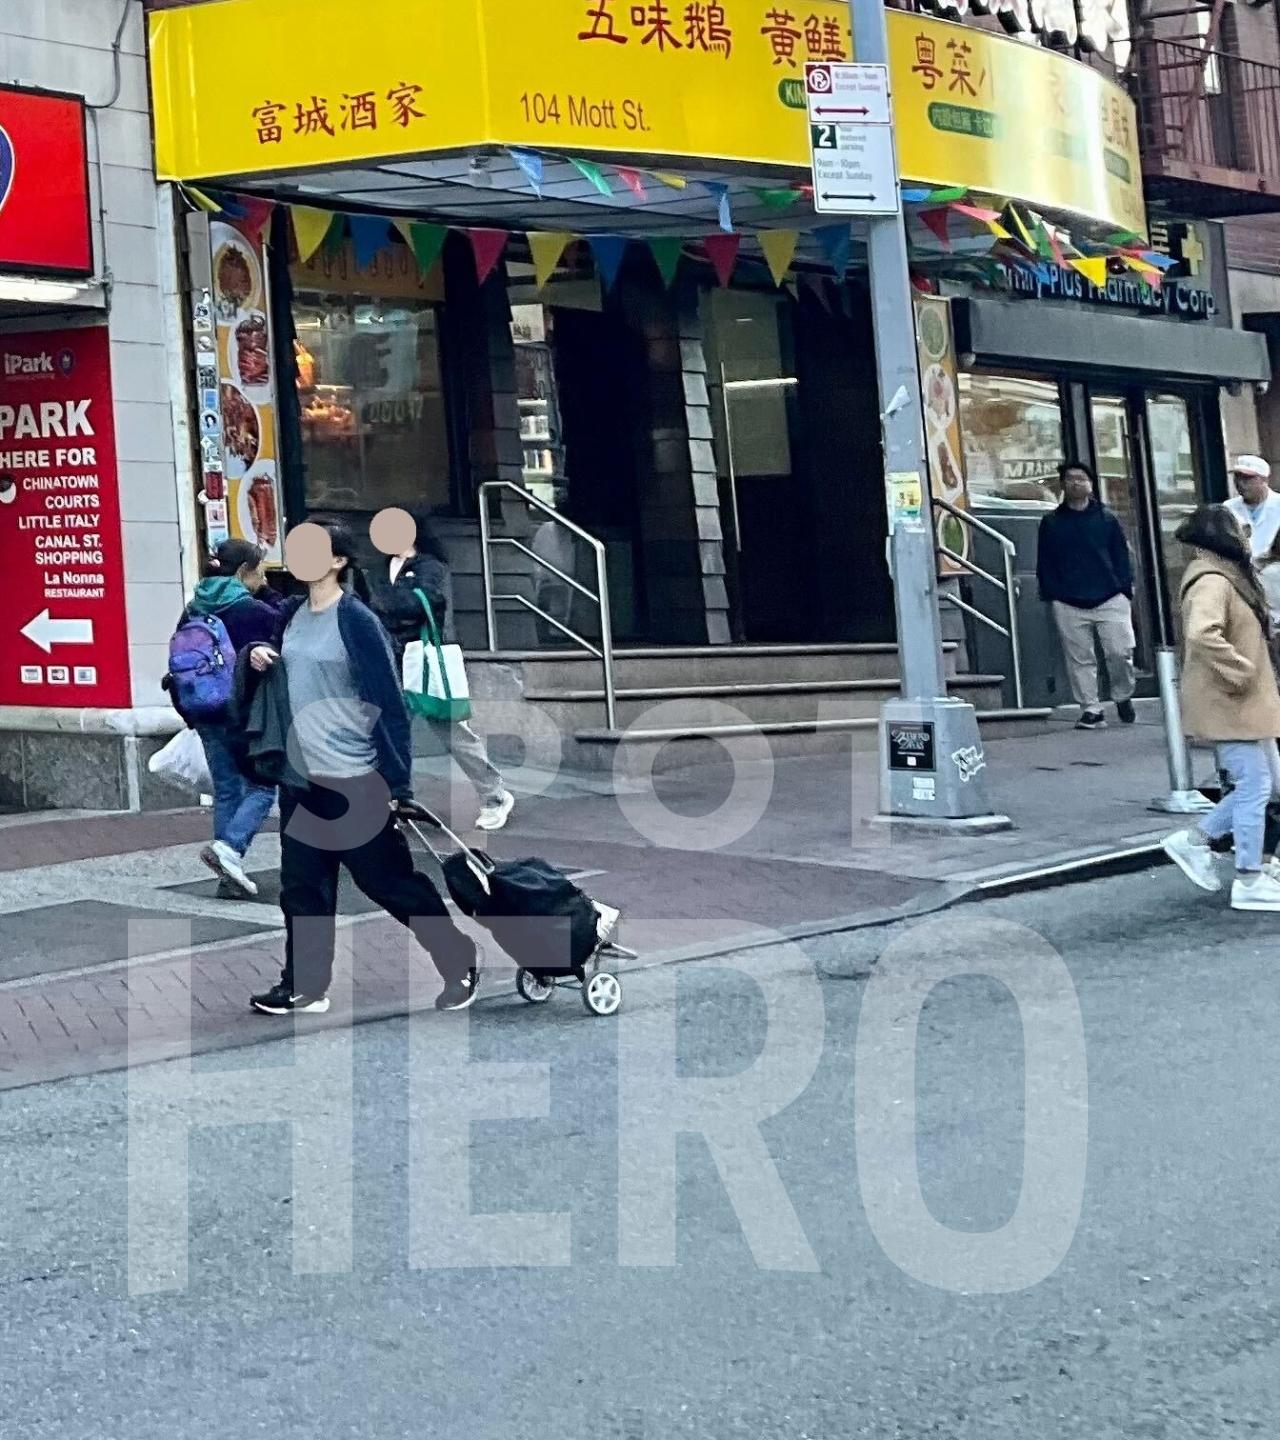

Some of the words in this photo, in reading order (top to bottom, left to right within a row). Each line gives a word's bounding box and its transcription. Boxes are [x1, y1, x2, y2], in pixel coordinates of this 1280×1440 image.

[760, 7, 851, 68] 黃鱔
[251, 81, 427, 145] 富城酒家
[520, 91, 561, 125] 104
[568, 96, 618, 130] Mott
[622, 99, 651, 132] St.
[818, 125, 832, 147] 2
[4, 351, 53, 375] iPark
[56, 447, 96, 466] FOR
[23, 474, 98, 491] CHINATOWN
[45, 494, 100, 509] COURTS
[18, 515, 61, 530] LITTLE
[65, 514, 100, 529] ITALY
[35, 534, 80, 549] CANAL
[83, 534, 103, 548] ST.
[35, 551, 103, 566] SHOPPING
[44, 571, 59, 585] La
[63, 571, 104, 585] Nonna
[44, 587, 104, 598] RESTAURANT
